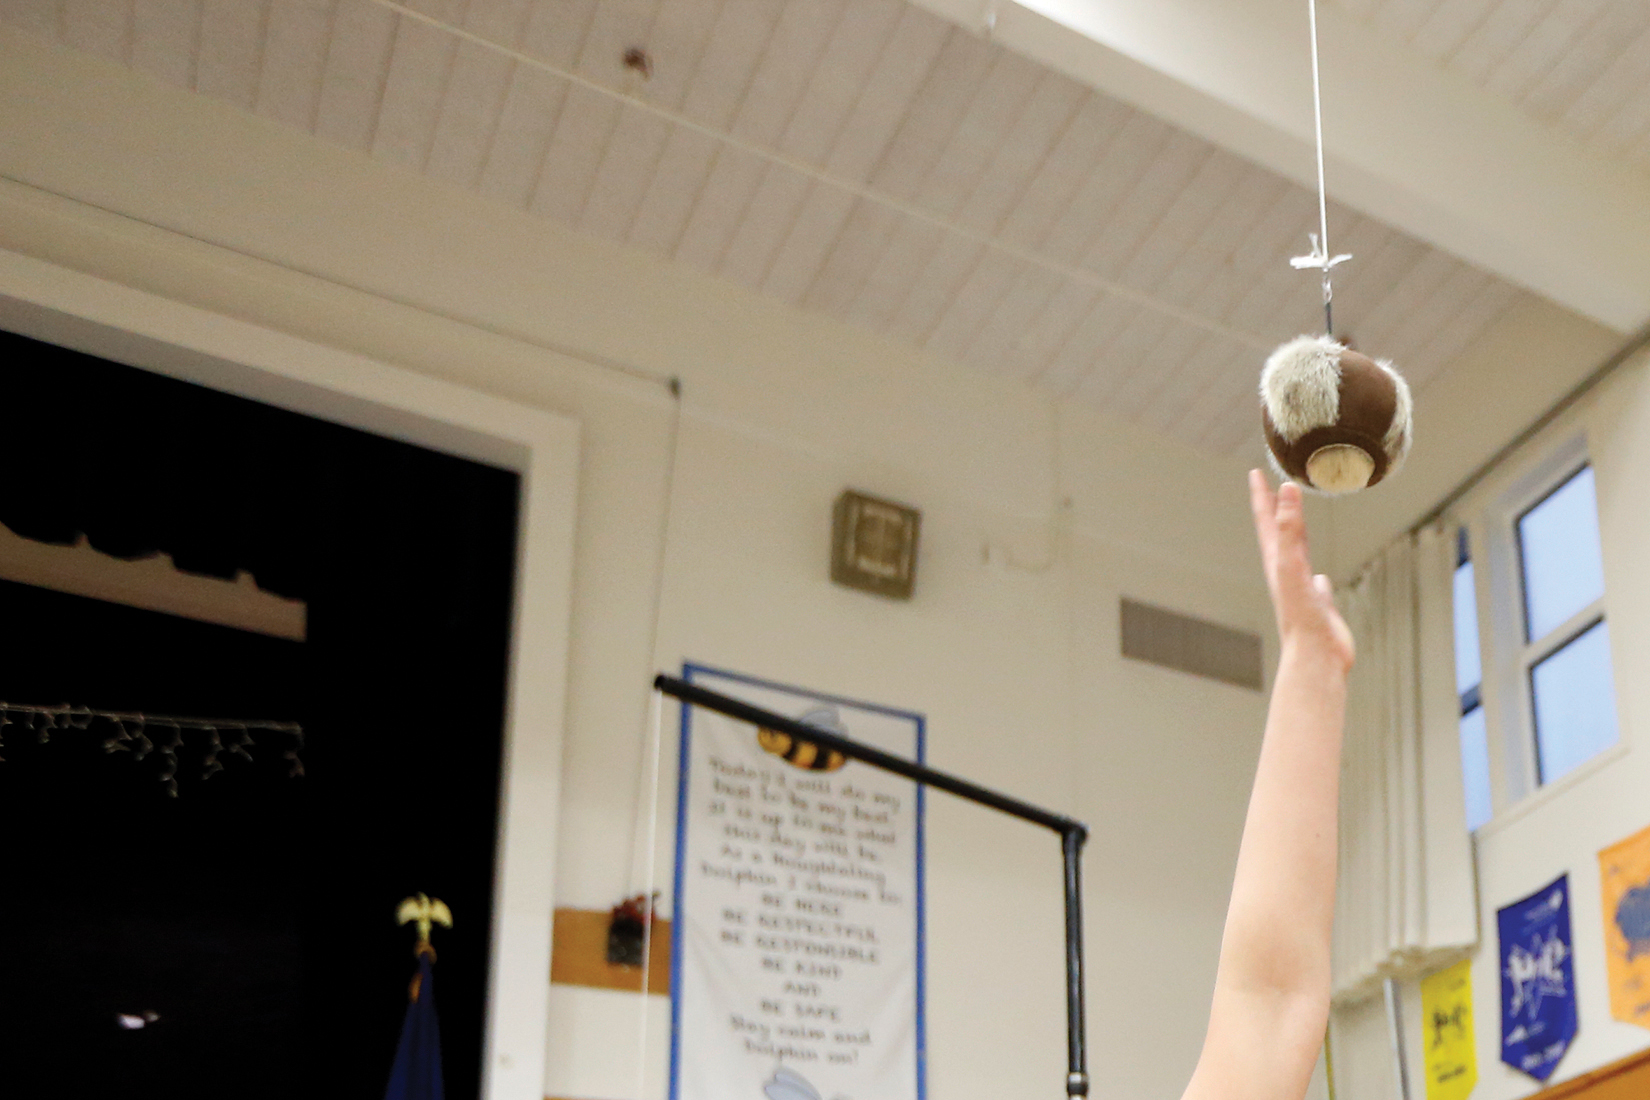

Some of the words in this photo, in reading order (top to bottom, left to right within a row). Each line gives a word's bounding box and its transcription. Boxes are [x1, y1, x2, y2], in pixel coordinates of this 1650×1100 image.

[761, 892, 783, 909] BE
[796, 898, 842, 918] HERE
[722, 907, 745, 925] BE
[720, 929, 743, 947] BE
[761, 956, 783, 973] BE
[796, 961, 842, 982] KIND
[785, 981, 821, 999] AND
[761, 1000, 783, 1016] BE
[796, 1004, 841, 1023] SAFE
[834, 1028, 872, 1045] and
